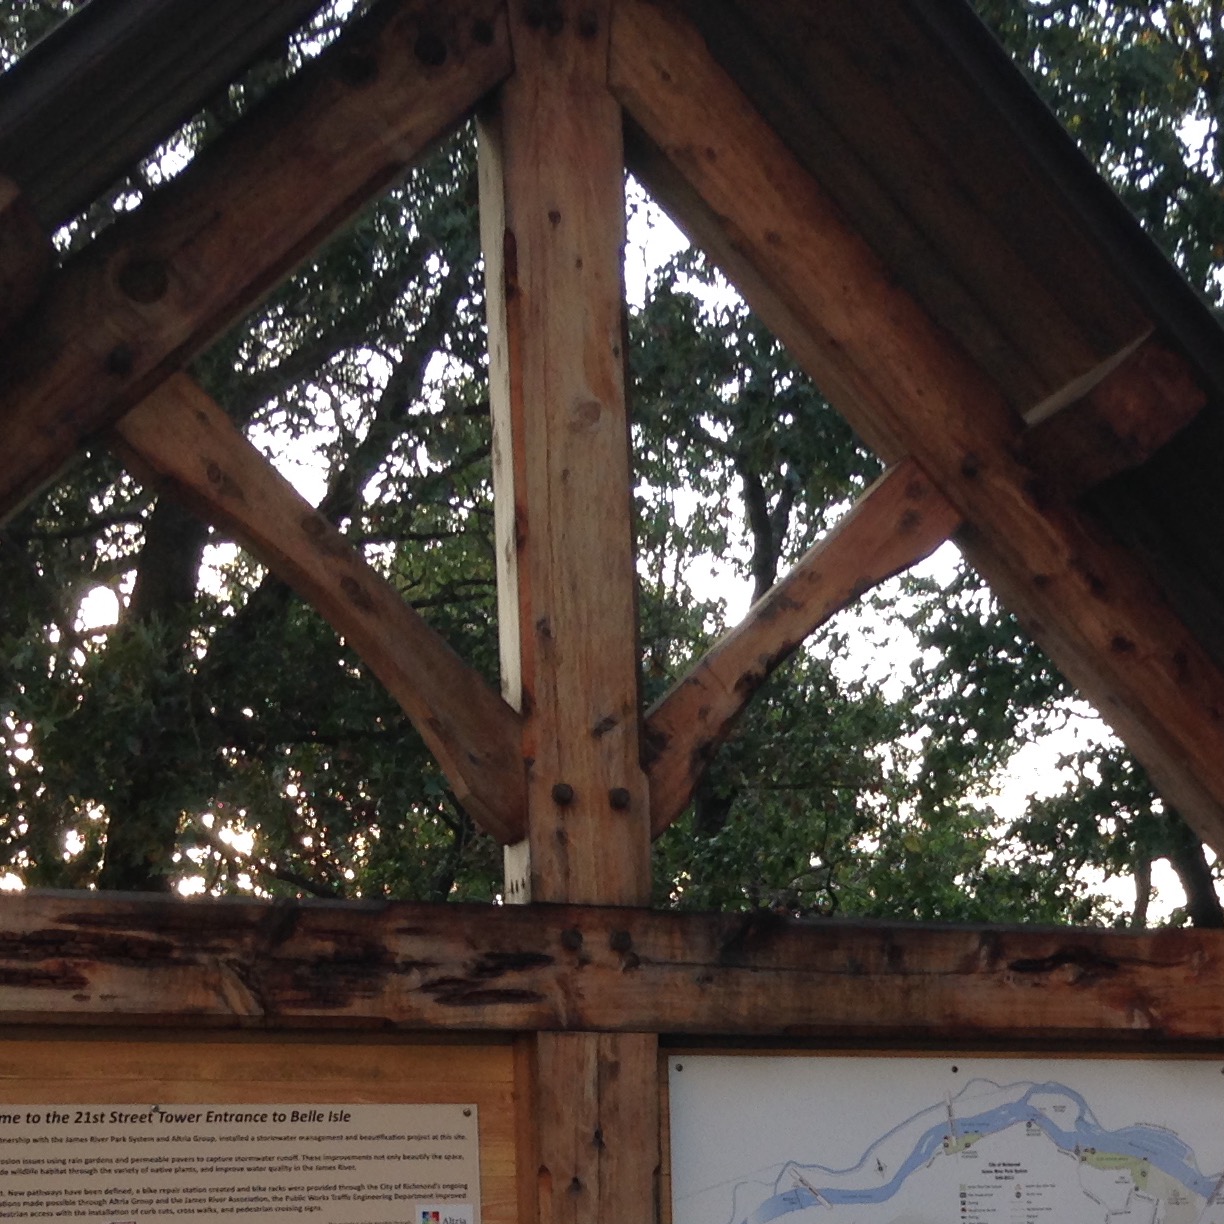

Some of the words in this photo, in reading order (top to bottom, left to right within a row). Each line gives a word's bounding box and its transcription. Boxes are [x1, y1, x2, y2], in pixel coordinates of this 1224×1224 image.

[26, 1112, 41, 1123] to
[46, 1111, 70, 1123] the
[74, 1111, 105, 1123] 21st
[109, 1111, 153, 1123] Street
[159, 1111, 202, 1123] Tower
[206, 1110, 268, 1123] Entrance
[272, 1112, 286, 1122] to
[291, 1110, 324, 1122] Belle
[328, 1110, 352, 1122] Isle
[443, 1217, 467, 1224] Altria
